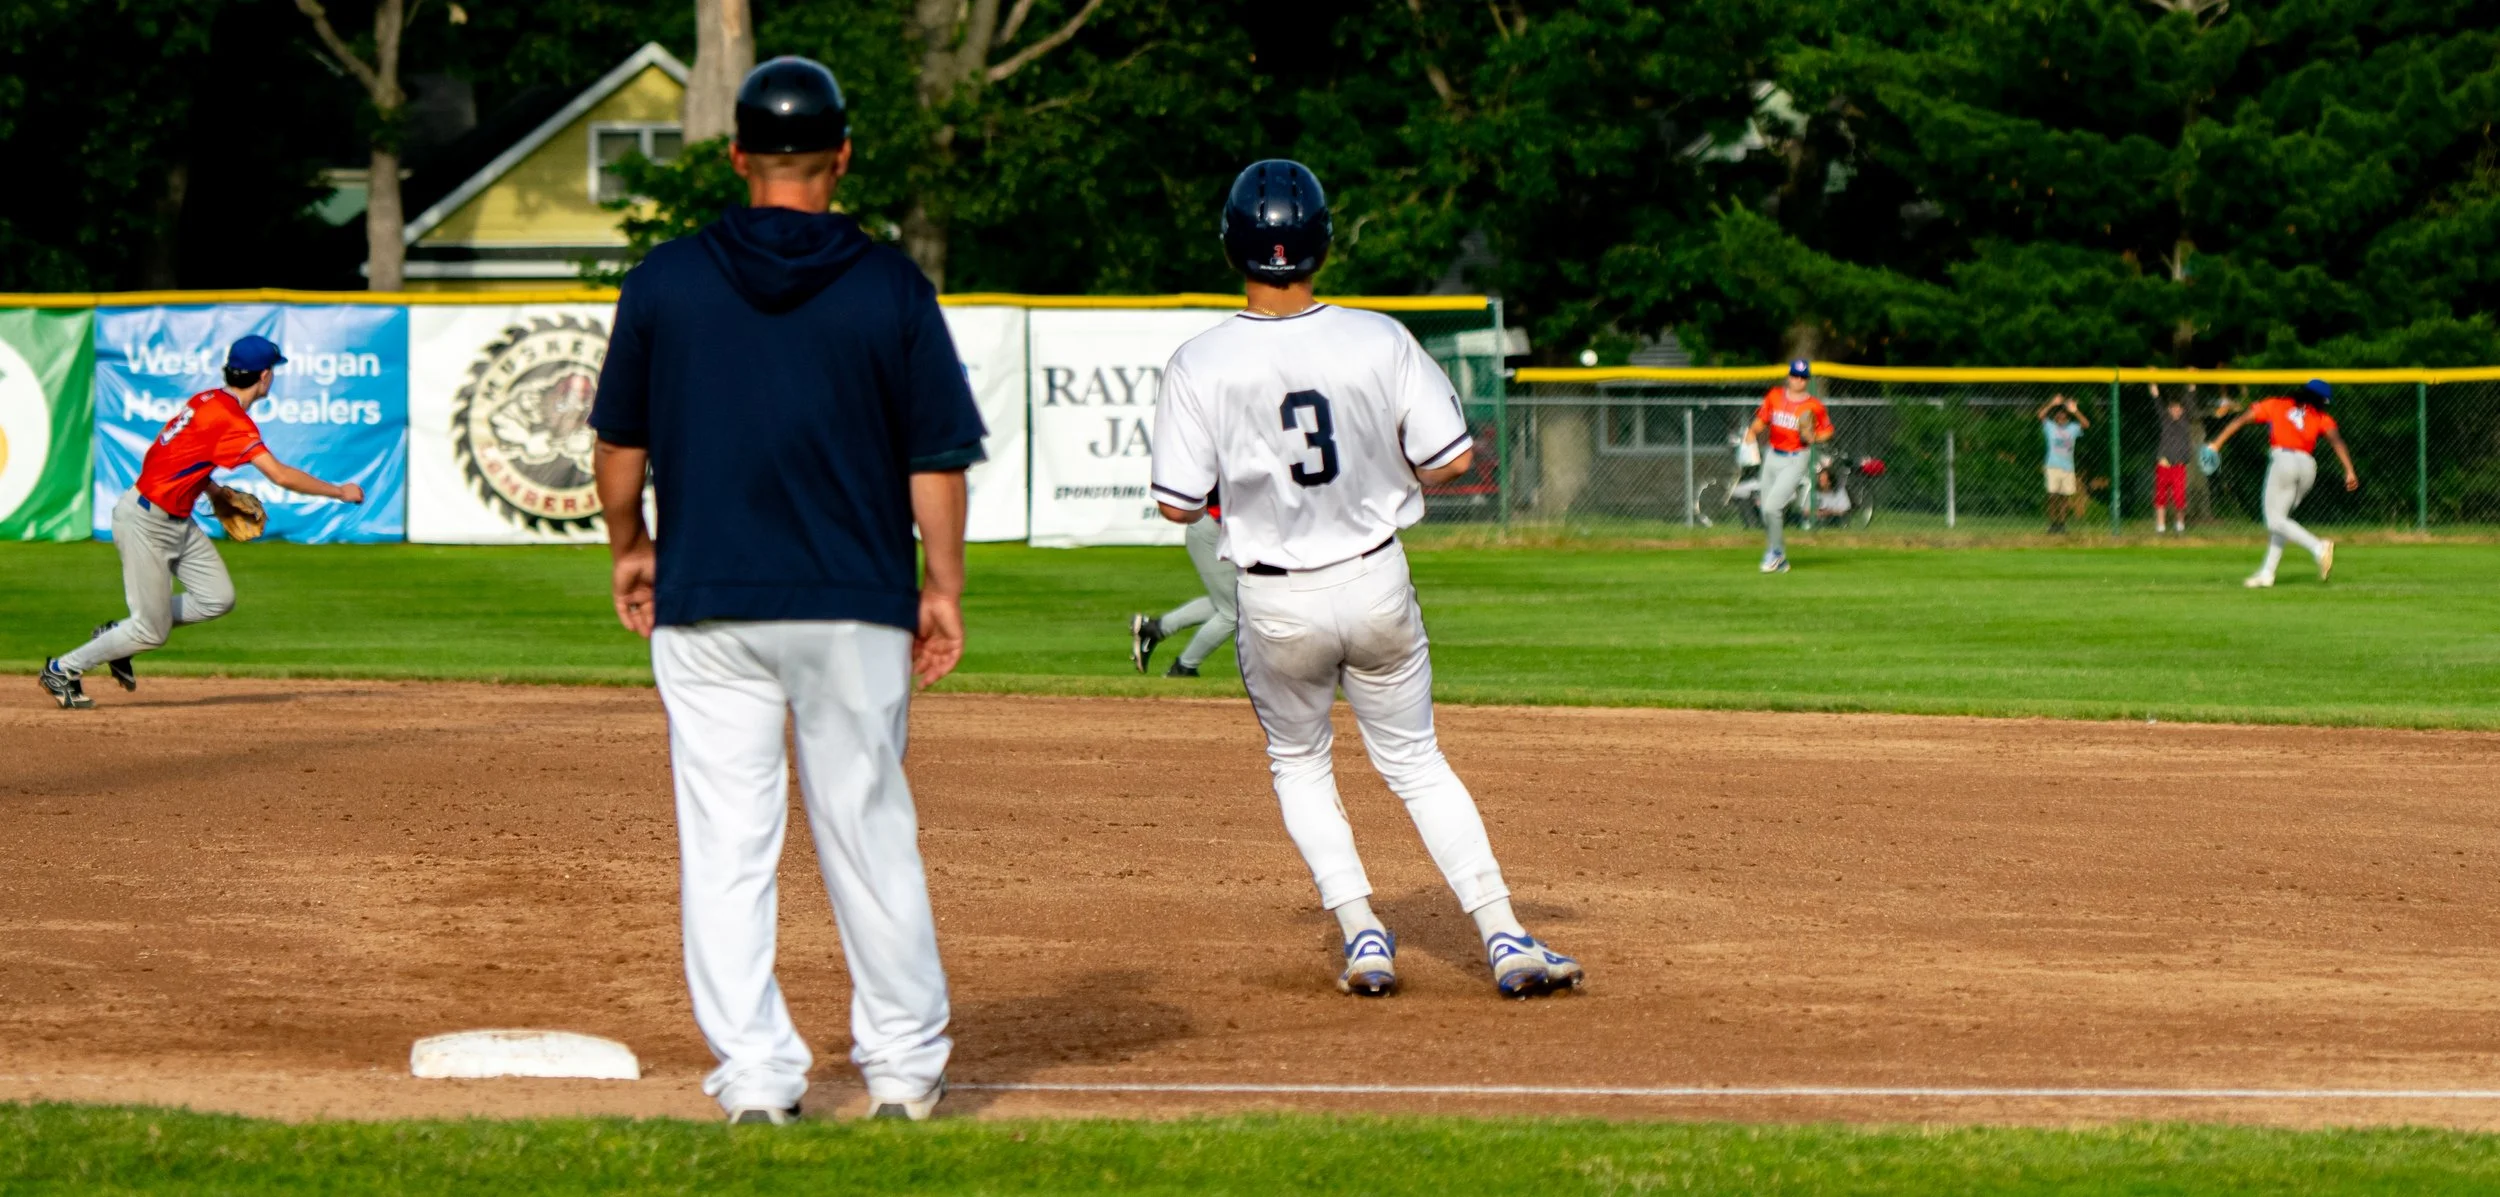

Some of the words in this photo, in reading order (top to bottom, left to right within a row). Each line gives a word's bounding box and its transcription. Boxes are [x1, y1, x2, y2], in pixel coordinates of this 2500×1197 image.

[123, 342, 212, 376] West
[223, 341, 381, 386] higan
[251, 387, 381, 424] Dealers
[1279, 388, 1340, 488] 3
[479, 441, 598, 512] LUMBERJ
[1054, 485, 1147, 500] SPONSORING
